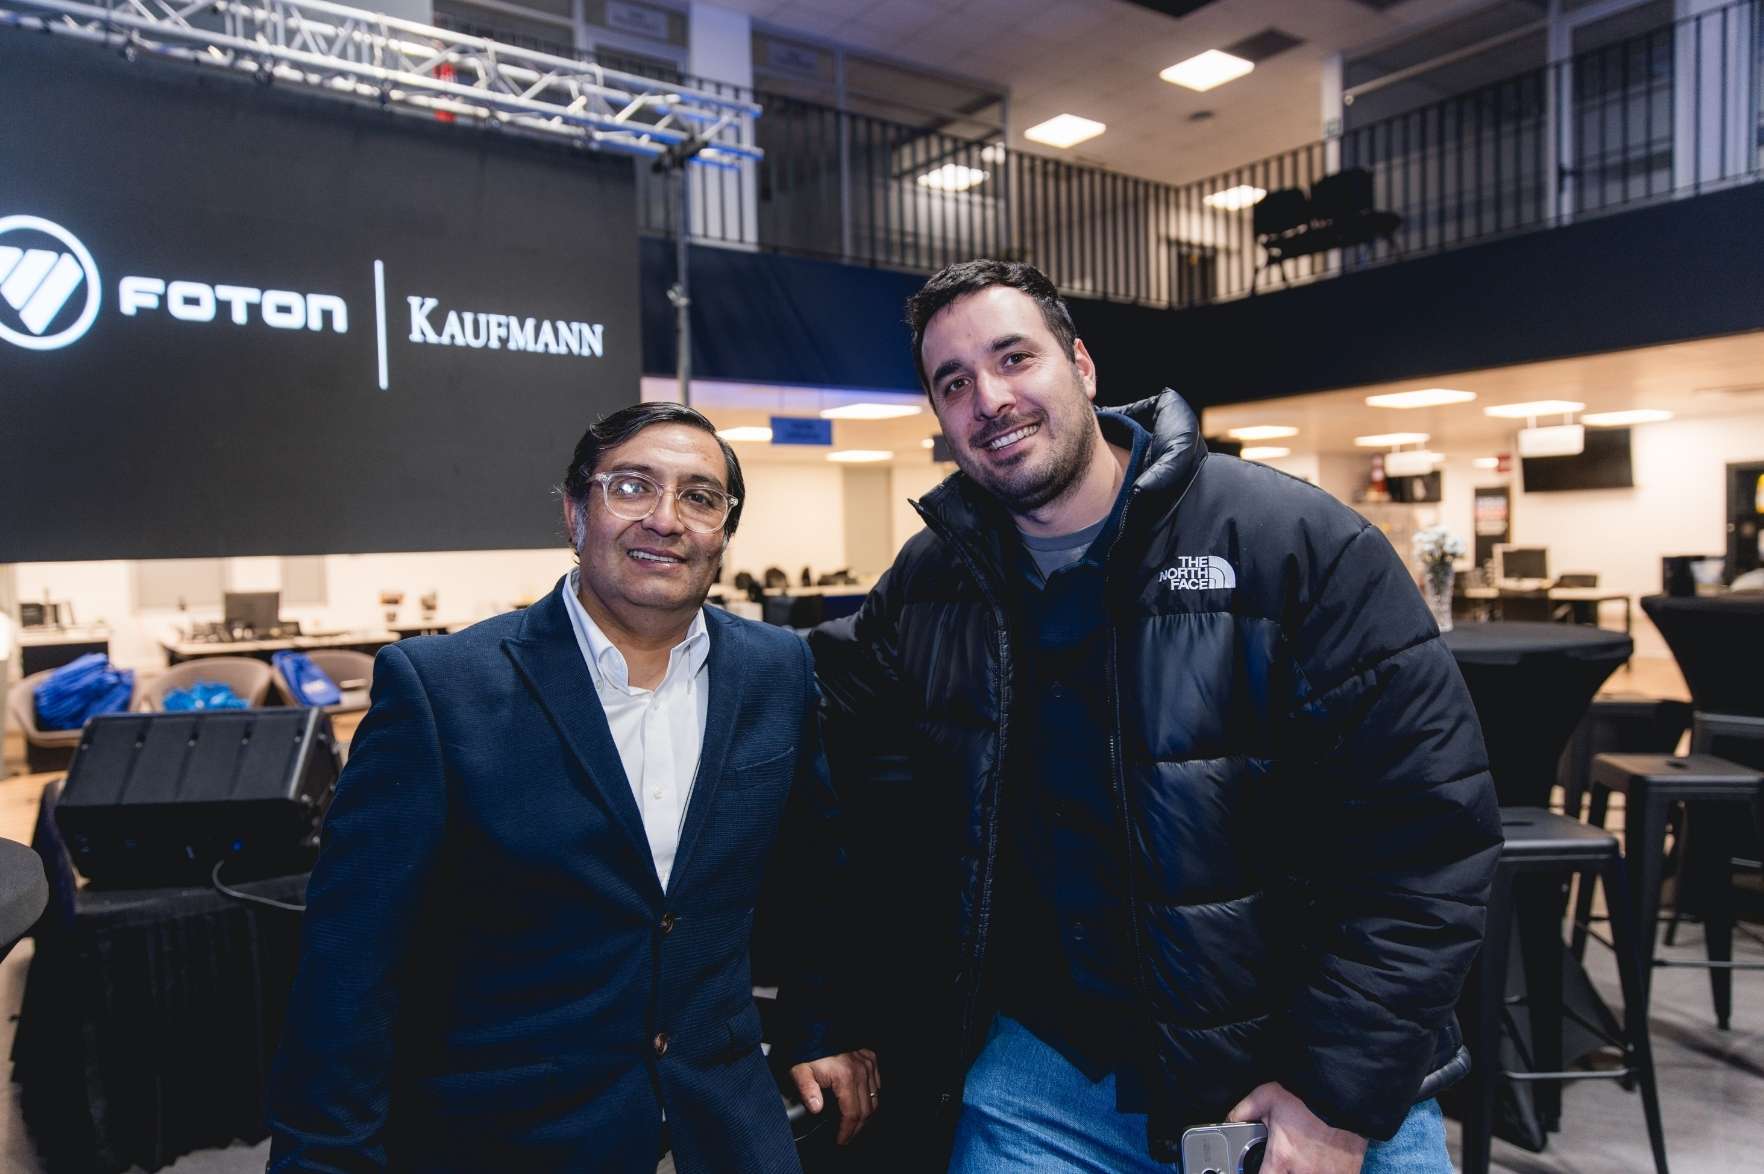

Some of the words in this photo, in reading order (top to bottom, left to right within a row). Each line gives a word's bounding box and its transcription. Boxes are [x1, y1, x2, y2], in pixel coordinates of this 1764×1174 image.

[118, 275, 349, 334] FOTON
[406, 295, 605, 358] KAUFMANN
[1178, 556, 1208, 567] THE
[1159, 567, 1208, 582] NORTH
[1170, 579, 1208, 590] FACE
